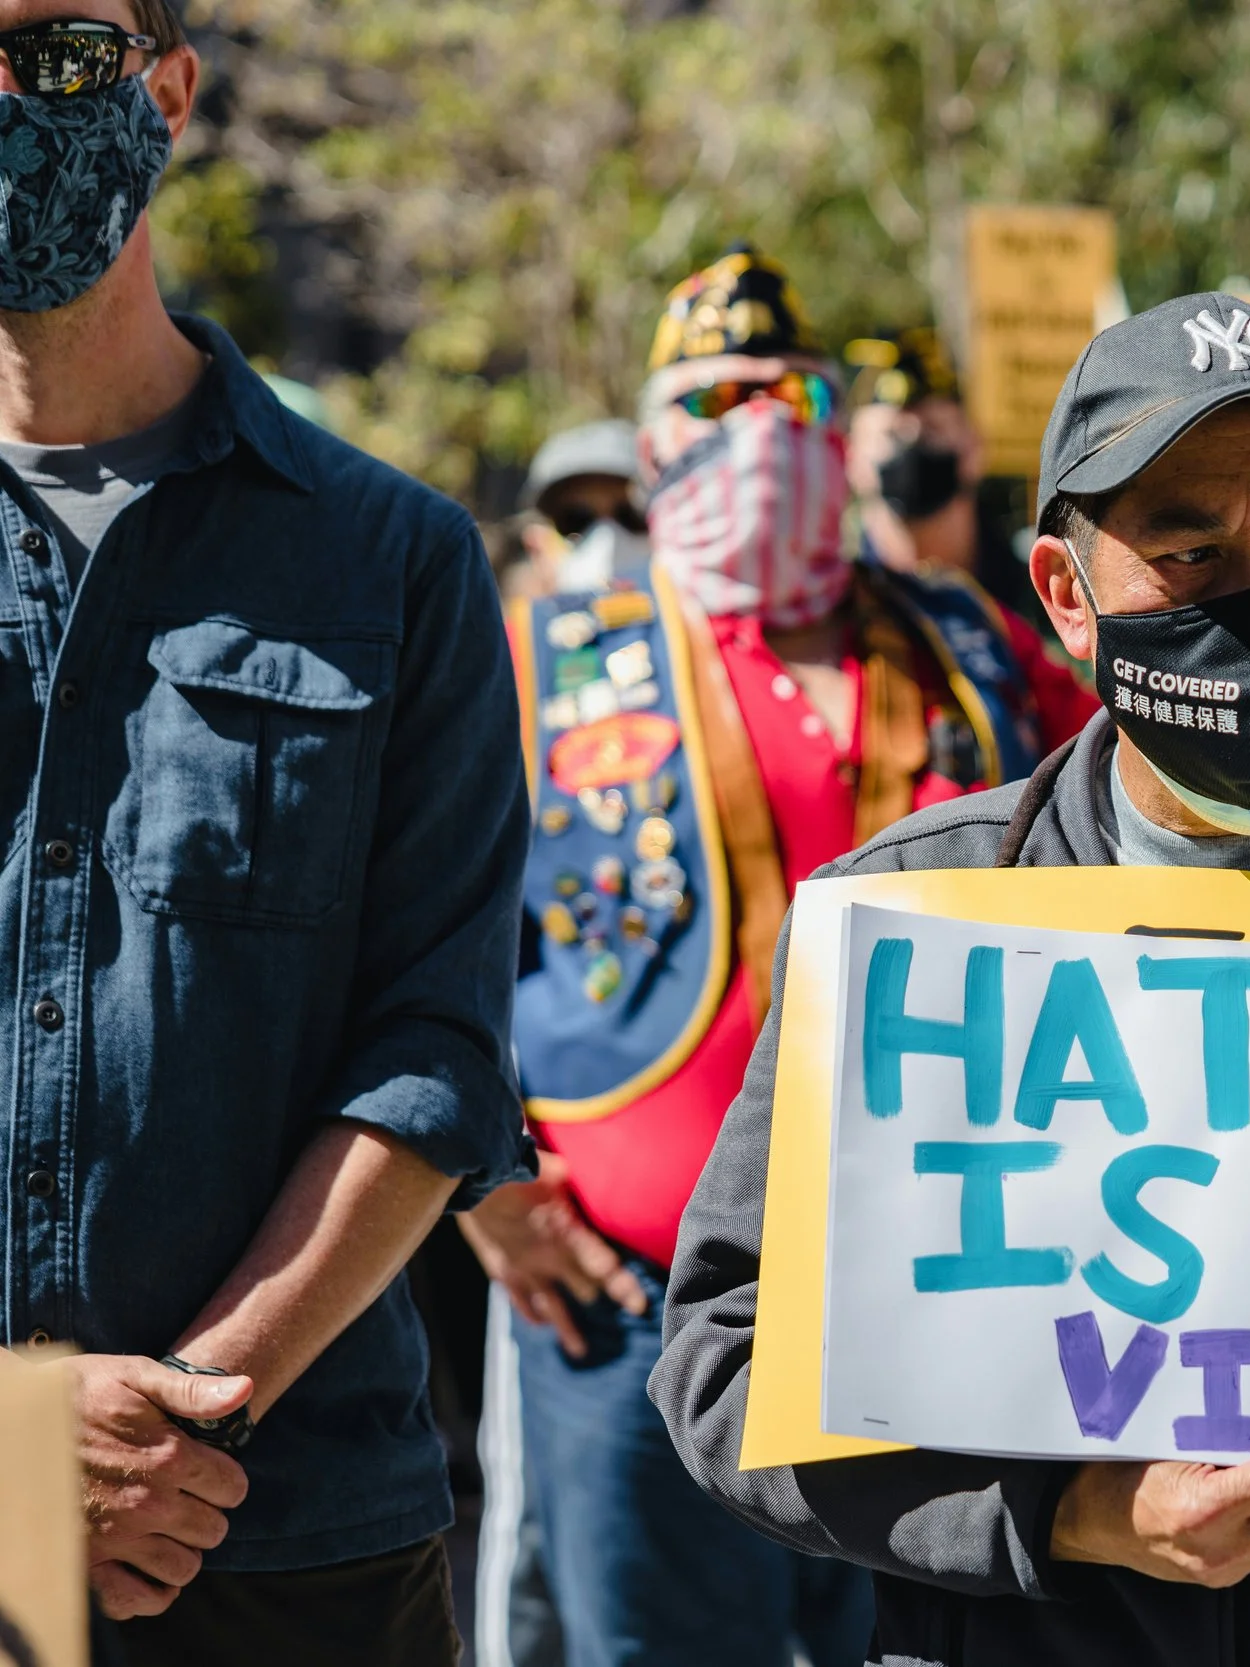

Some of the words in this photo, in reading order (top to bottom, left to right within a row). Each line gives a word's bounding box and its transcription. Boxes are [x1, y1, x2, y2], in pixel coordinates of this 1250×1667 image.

[1113, 658, 1147, 685] GET
[1148, 670, 1240, 702] COVERED
[1114, 684, 1239, 735] 獲得健康保護
[912, 1141, 1221, 1325] IS
